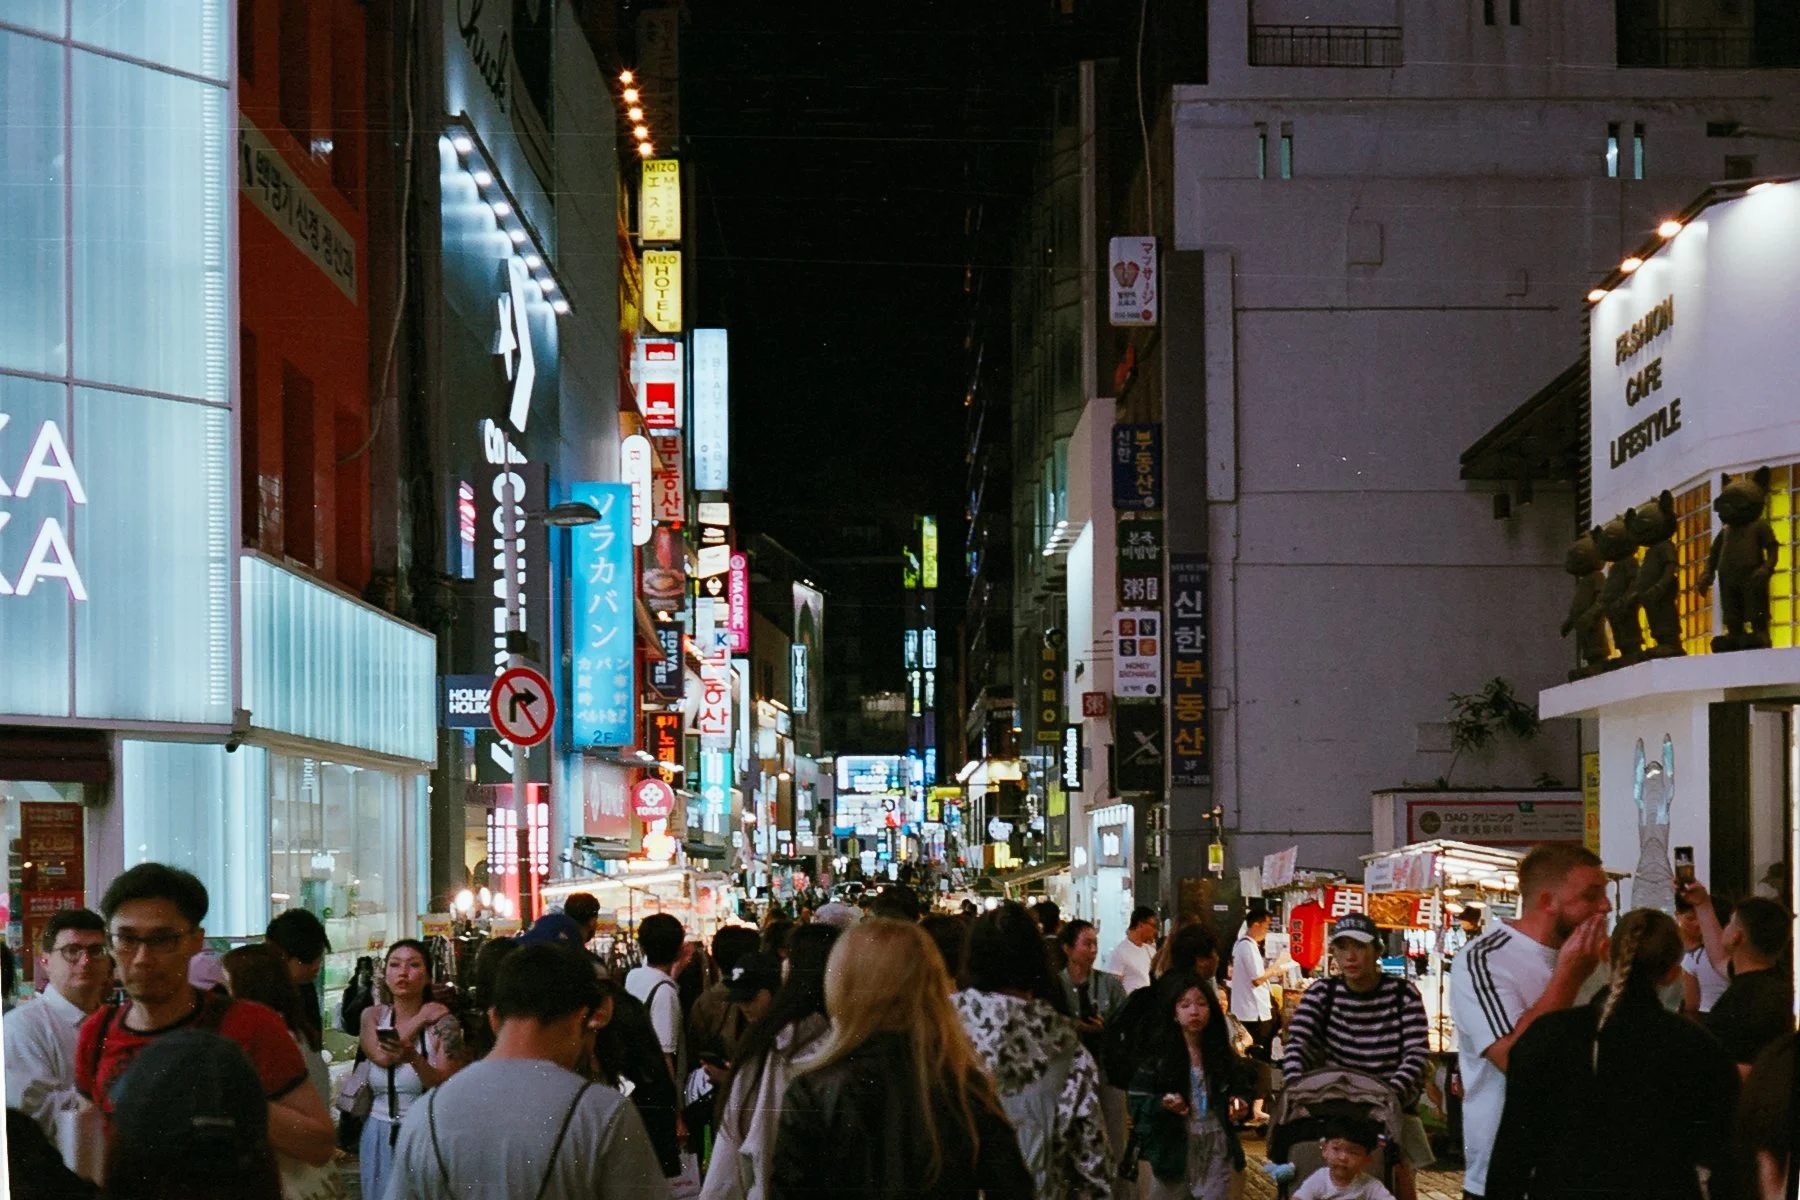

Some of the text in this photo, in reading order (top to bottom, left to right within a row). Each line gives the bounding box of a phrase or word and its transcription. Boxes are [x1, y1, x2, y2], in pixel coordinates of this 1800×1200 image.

[645, 162, 677, 173] MIZO
[646, 255, 677, 265] MIZO
[654, 265, 670, 322] HOTEL
[1615, 294, 1674, 366] FASHION
[1626, 356, 1662, 407] CAFE
[1610, 397, 1682, 470] LIFESTYLE
[1134, 430, 1153, 496] 부동산
[588, 492, 619, 648] ソラカバン
[666, 630, 678, 673] EDIYA
[716, 633, 727, 647] K
[449, 700, 490, 714] HOLIK
[593, 729, 614, 744] 2F
